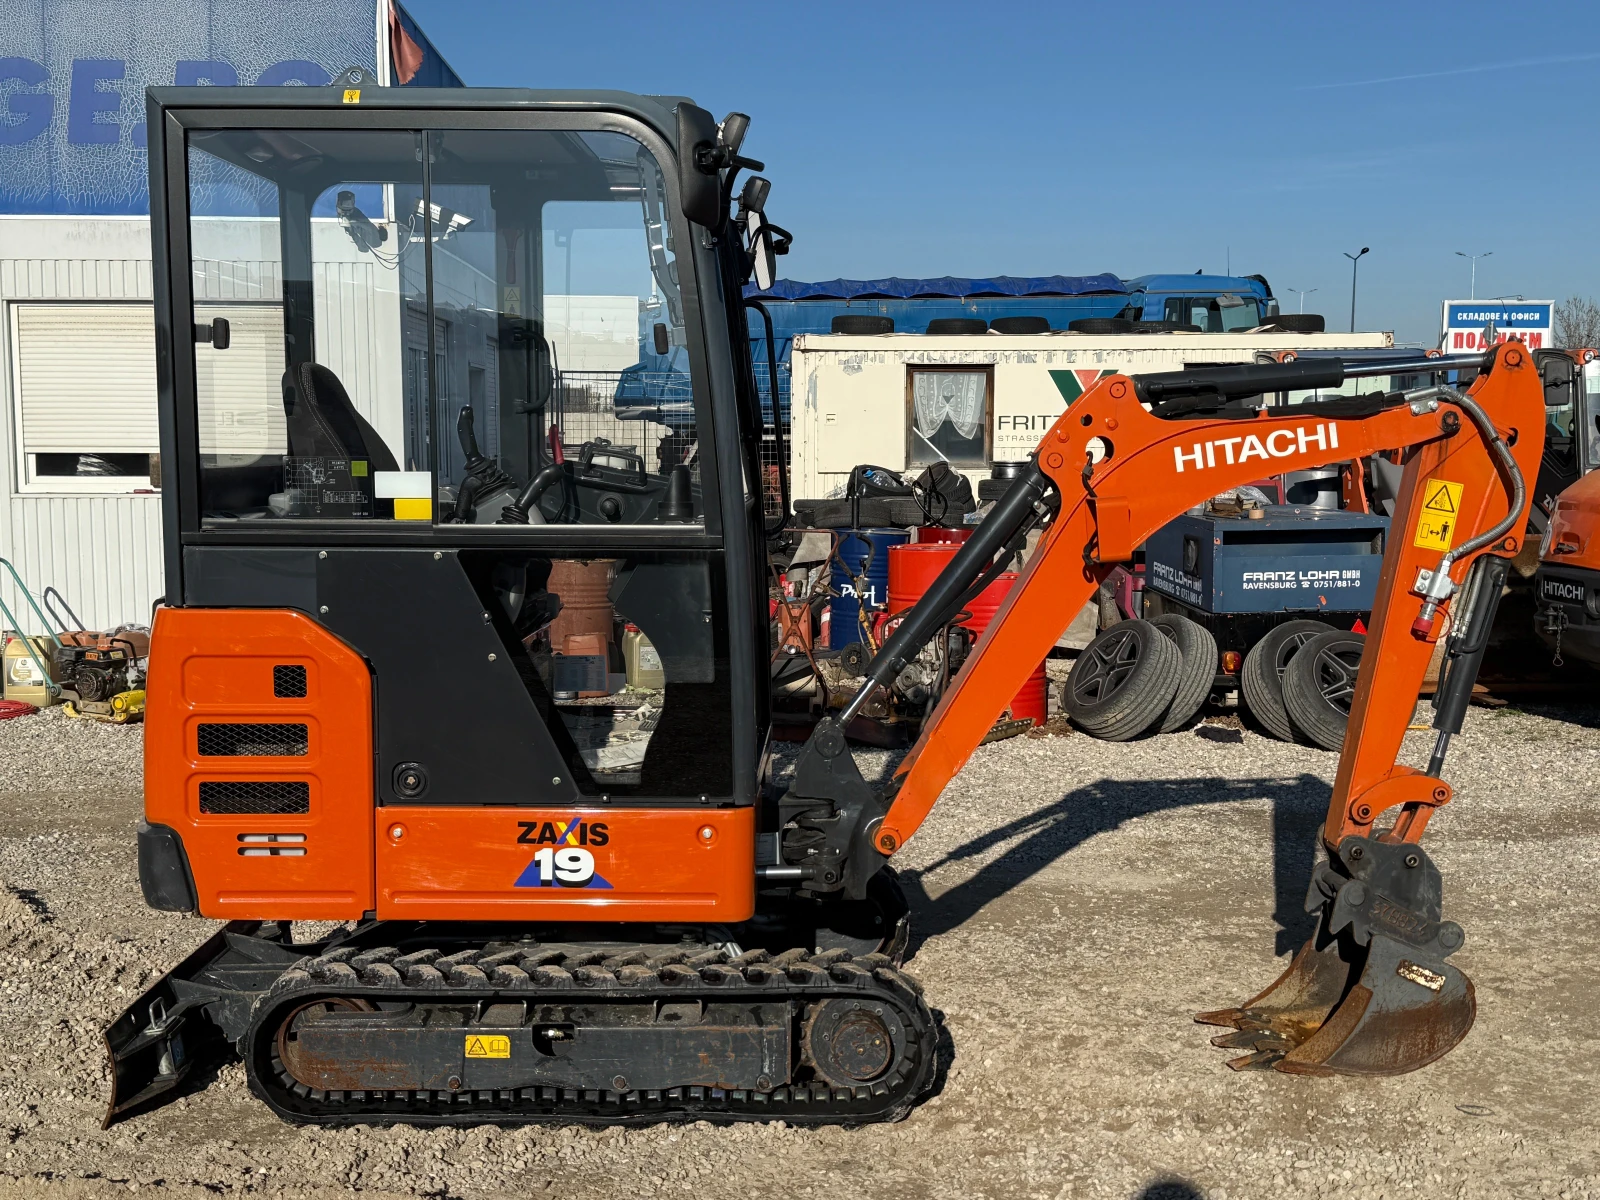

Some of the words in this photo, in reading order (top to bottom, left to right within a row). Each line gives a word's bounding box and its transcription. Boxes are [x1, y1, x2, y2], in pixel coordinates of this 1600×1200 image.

[1457, 312, 1500, 321] СКЛАДОВЕ
[1511, 312, 1540, 320] ОФИСИ
[998, 415, 1061, 430] FRIT
[1174, 422, 1339, 473] HITACHI
[1243, 571, 1296, 581] FRANZ
[1298, 570, 1340, 580] LOHR
[1242, 581, 1297, 590] RAVENSBURG
[1313, 580, 1361, 588] 0751/881-0
[1544, 580, 1584, 601] HITACHI
[517, 817, 610, 847] ZAXIS
[534, 847, 595, 888] 19
